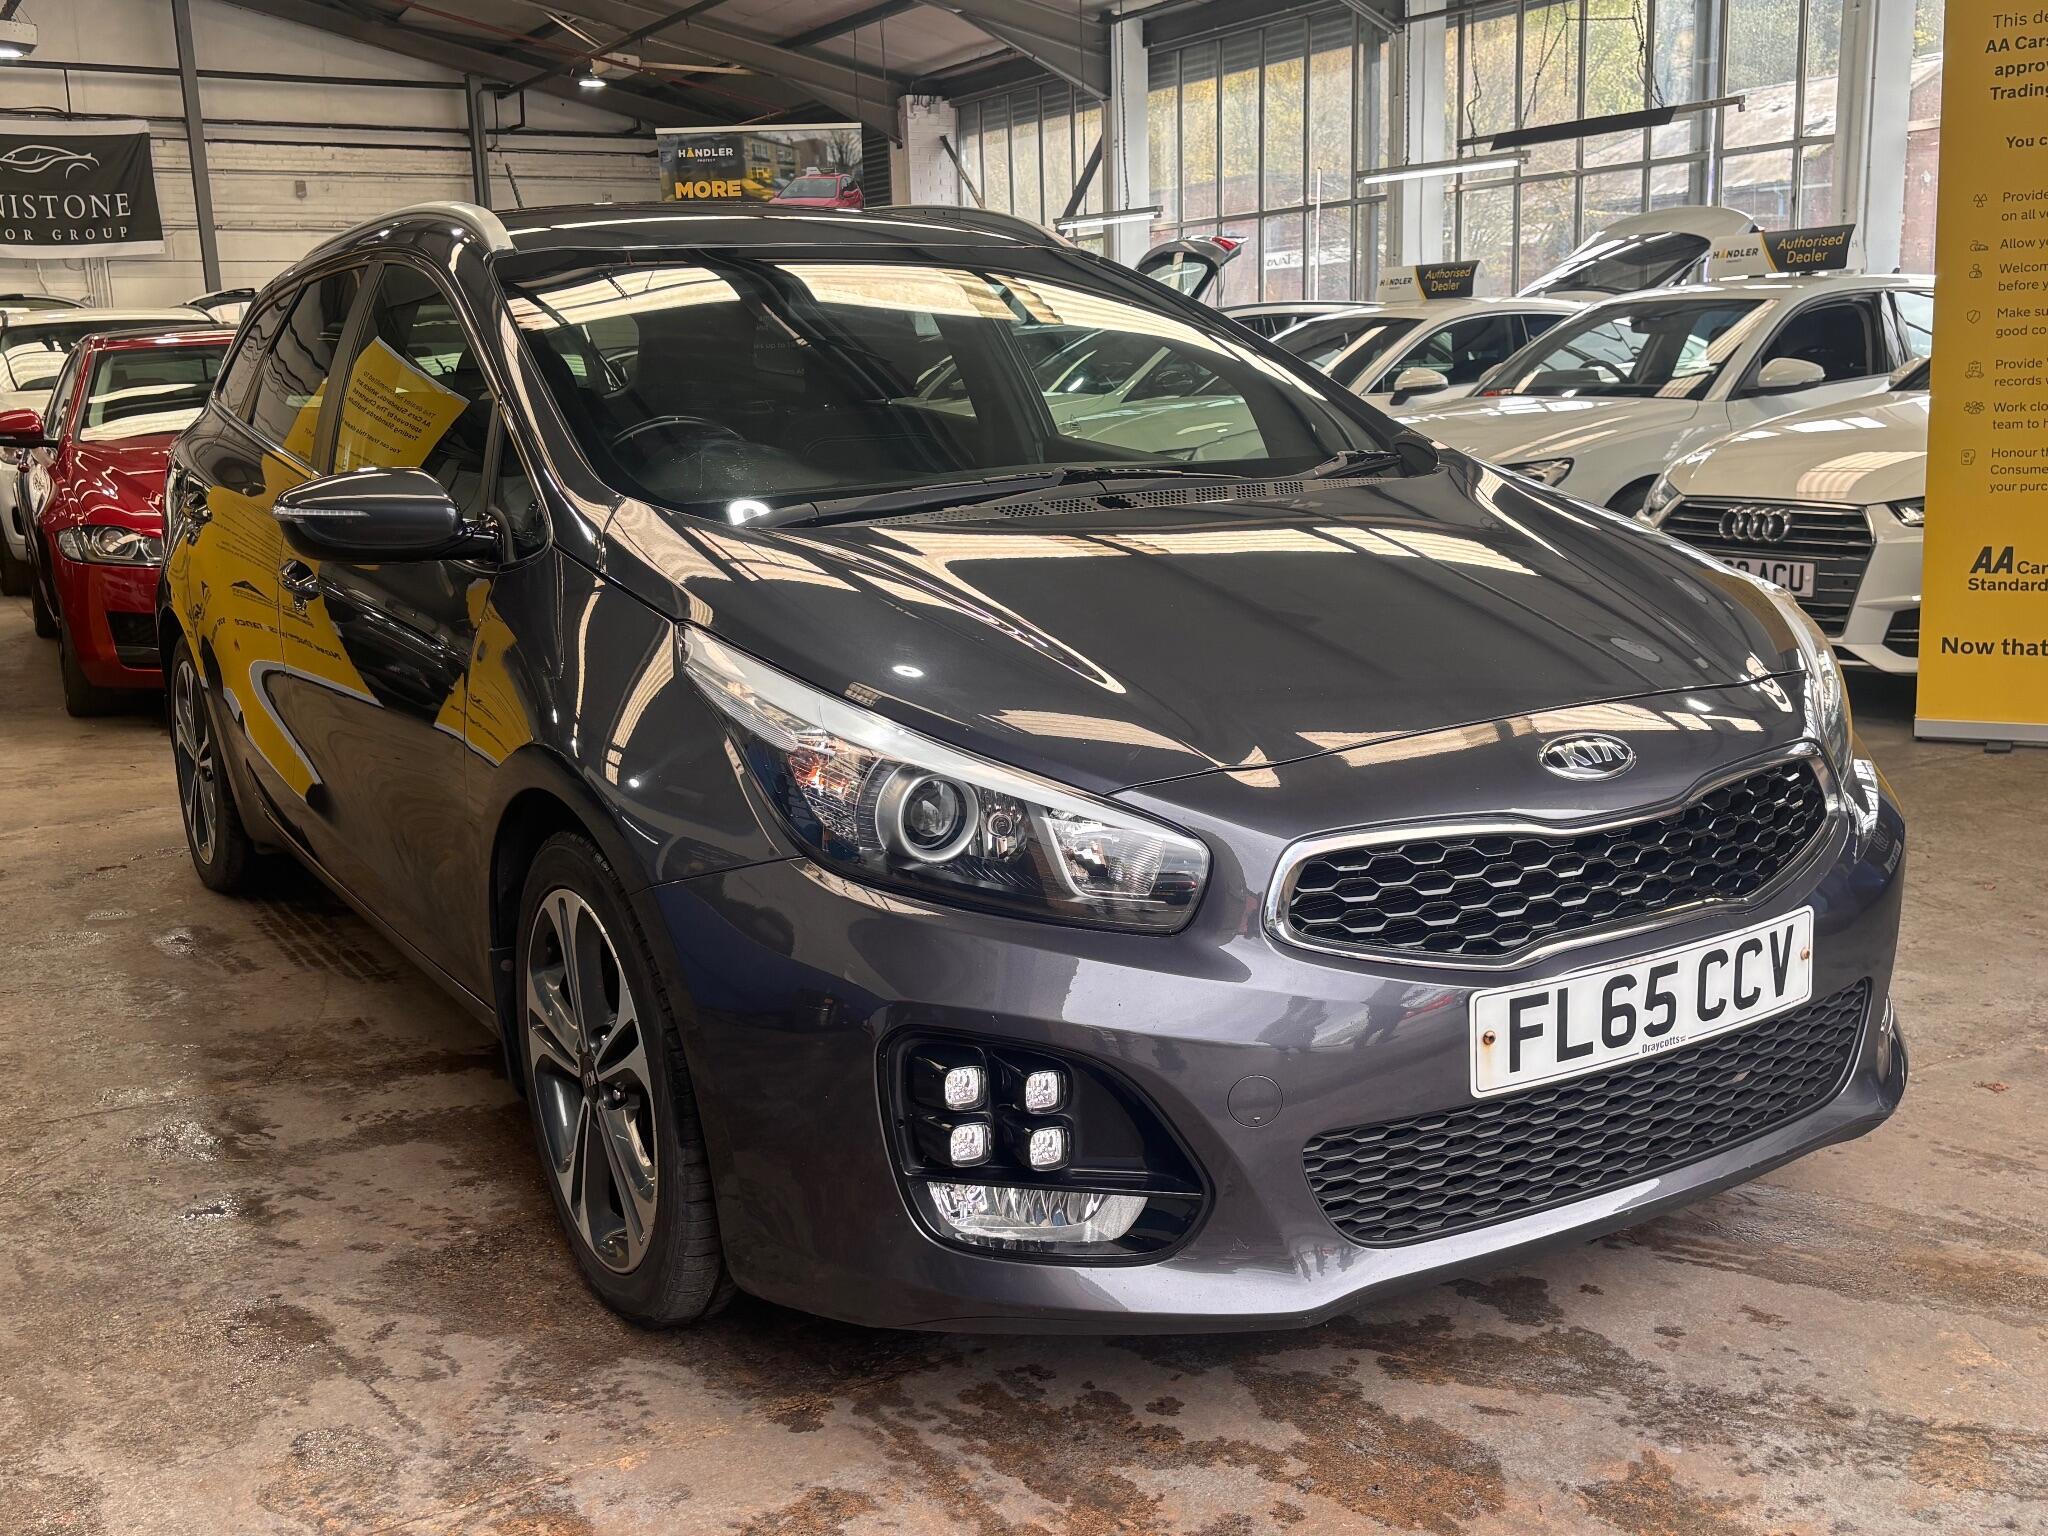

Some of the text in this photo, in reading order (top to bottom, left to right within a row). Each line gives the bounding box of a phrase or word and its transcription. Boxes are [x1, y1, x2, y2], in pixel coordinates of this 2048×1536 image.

[1993, 12, 2027, 28] This
[1985, 38, 2010, 53] AA
[1994, 61, 2048, 78] appro
[2006, 136, 2034, 149] You
[675, 180, 742, 199] MORE
[2001, 208, 2048, 221] on all v
[5, 226, 127, 241] OR GROUP
[1777, 231, 1845, 250] Authorised
[2000, 238, 2036, 249] Allow
[1786, 250, 1828, 264] Dealer
[1425, 267, 1472, 280] Authorised
[1430, 280, 1460, 292] Dealer
[1998, 280, 2039, 292] before
[1997, 307, 2031, 319] Make
[1995, 324, 2047, 339] good co
[1995, 357, 2043, 370] Provide
[1994, 376, 2042, 387] records
[1993, 401, 2027, 413] Work
[1993, 420, 2023, 430] team
[2027, 419, 2039, 429] to
[1991, 448, 2038, 458] Honour
[1990, 464, 2048, 475] Consume
[1990, 483, 2048, 493] your purc
[1969, 546, 2048, 574] AA Car
[1968, 578, 2048, 592] Standard
[1941, 636, 2048, 657] Now that
[1548, 738, 1626, 769] KIA
[1509, 924, 1794, 1074] FL65 CCV
[1642, 1036, 1680, 1053] Draycotts
